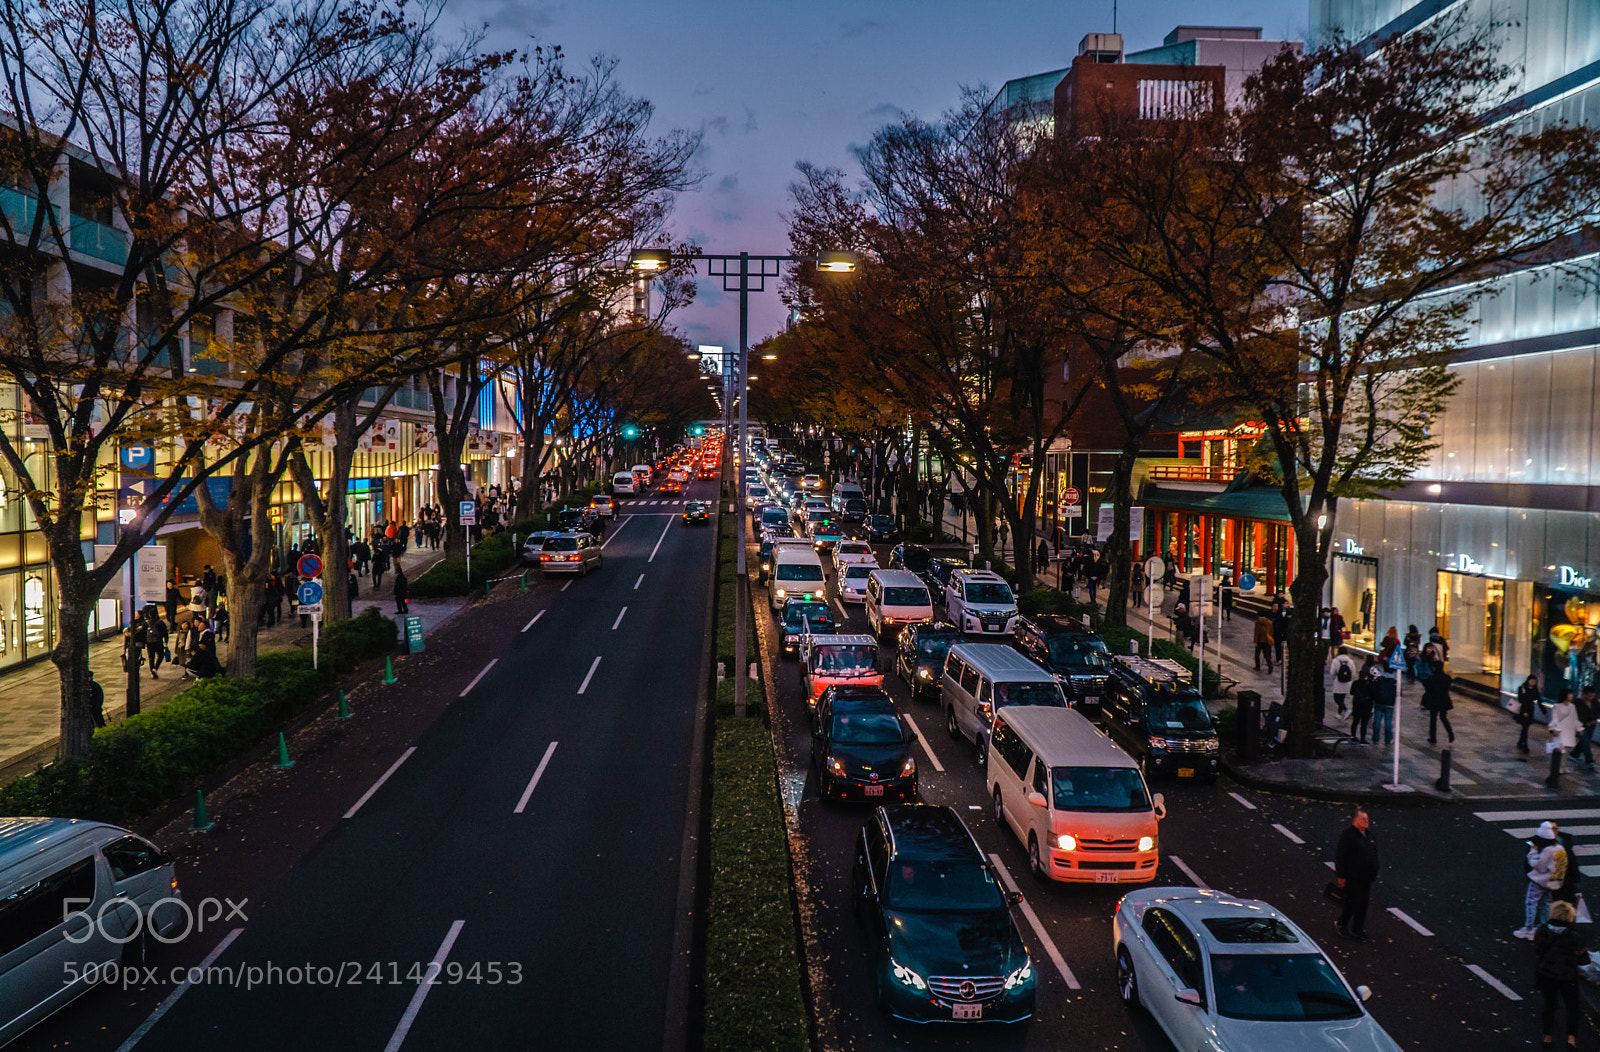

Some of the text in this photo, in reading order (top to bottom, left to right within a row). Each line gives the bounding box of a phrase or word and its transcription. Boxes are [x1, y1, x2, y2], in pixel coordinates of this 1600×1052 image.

[128, 447, 145, 463] P
[461, 502, 474, 515] P
[1346, 538, 1364, 555] Dior
[1459, 553, 1484, 574] Dior
[1559, 565, 1592, 588] Dior
[303, 587, 313, 602] P
